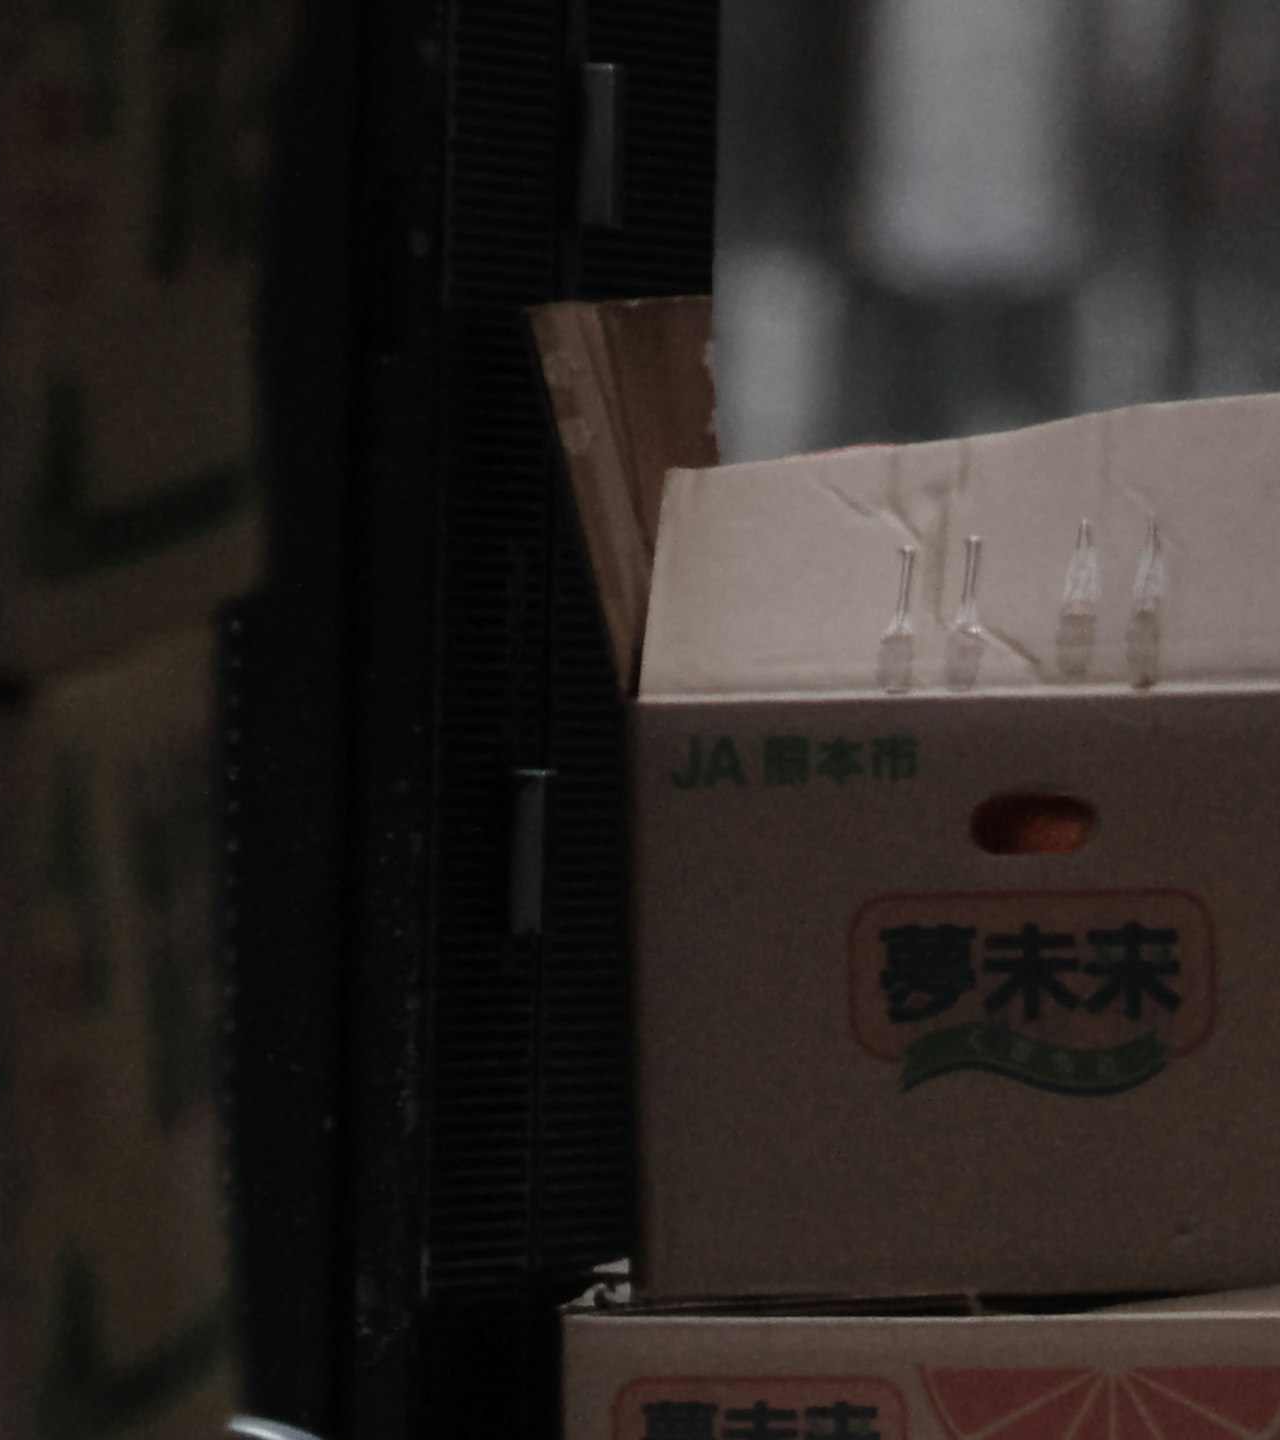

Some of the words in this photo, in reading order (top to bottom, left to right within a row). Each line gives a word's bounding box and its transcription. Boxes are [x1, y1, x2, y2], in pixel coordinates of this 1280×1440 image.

[671, 736, 748, 790] JA
[879, 922, 1182, 1023] 夢未来
